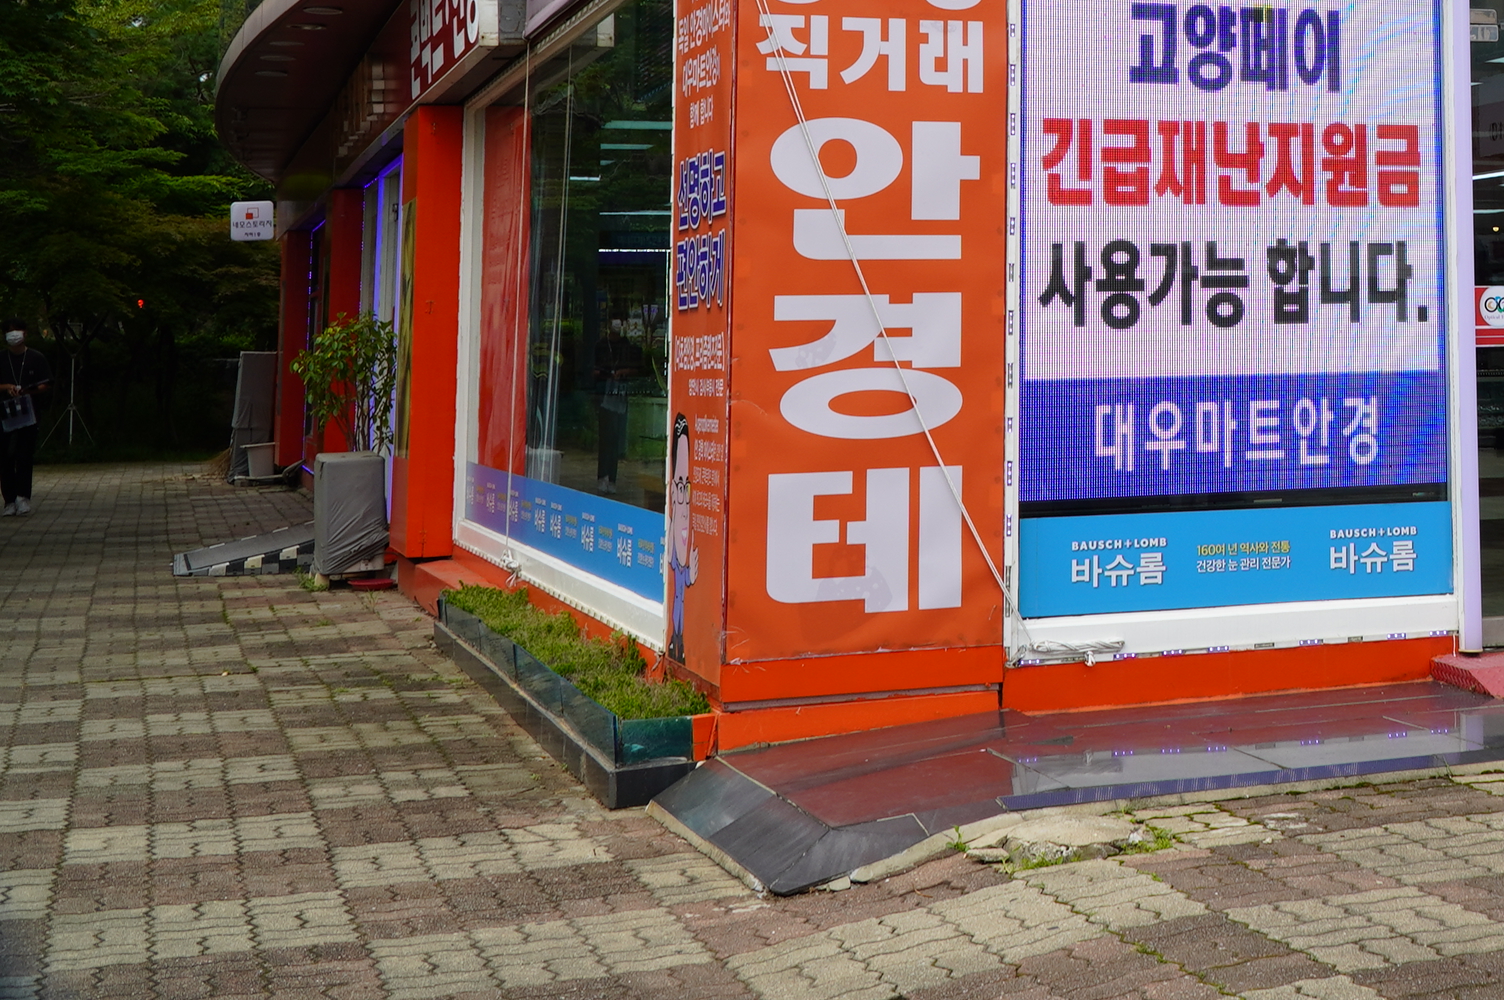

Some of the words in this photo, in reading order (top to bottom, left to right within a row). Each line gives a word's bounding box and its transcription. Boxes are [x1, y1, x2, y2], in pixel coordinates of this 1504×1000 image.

[755, 13, 985, 93] 직거래
[678, 147, 727, 232] 선명하고
[1041, 117, 1422, 209] 긴급재난지원금
[676, 227, 726, 311] 편안하게
[1038, 238, 1250, 330] 사용가능
[1266, 238, 1429, 325] 합니다.
[765, 116, 981, 614] 안경테
[1095, 395, 1380, 472] 대우마트안경
[1070, 551, 1168, 588] 바슈롬
[1071, 537, 1168, 551] BAUSCH+LOMB
[1196, 543, 1226, 557] 160여
[1228, 543, 1238, 556] 년
[1239, 541, 1270, 556] 역사와
[1271, 540, 1291, 554] 전통
[1196, 558, 1227, 573] 건강한
[1228, 558, 1238, 573] 눈
[1239, 557, 1260, 572] 관리
[1261, 555, 1291, 571] 전문가
[1329, 526, 1418, 539] BAUSCH+LOMB
[1329, 540, 1418, 574] 바슈롬
